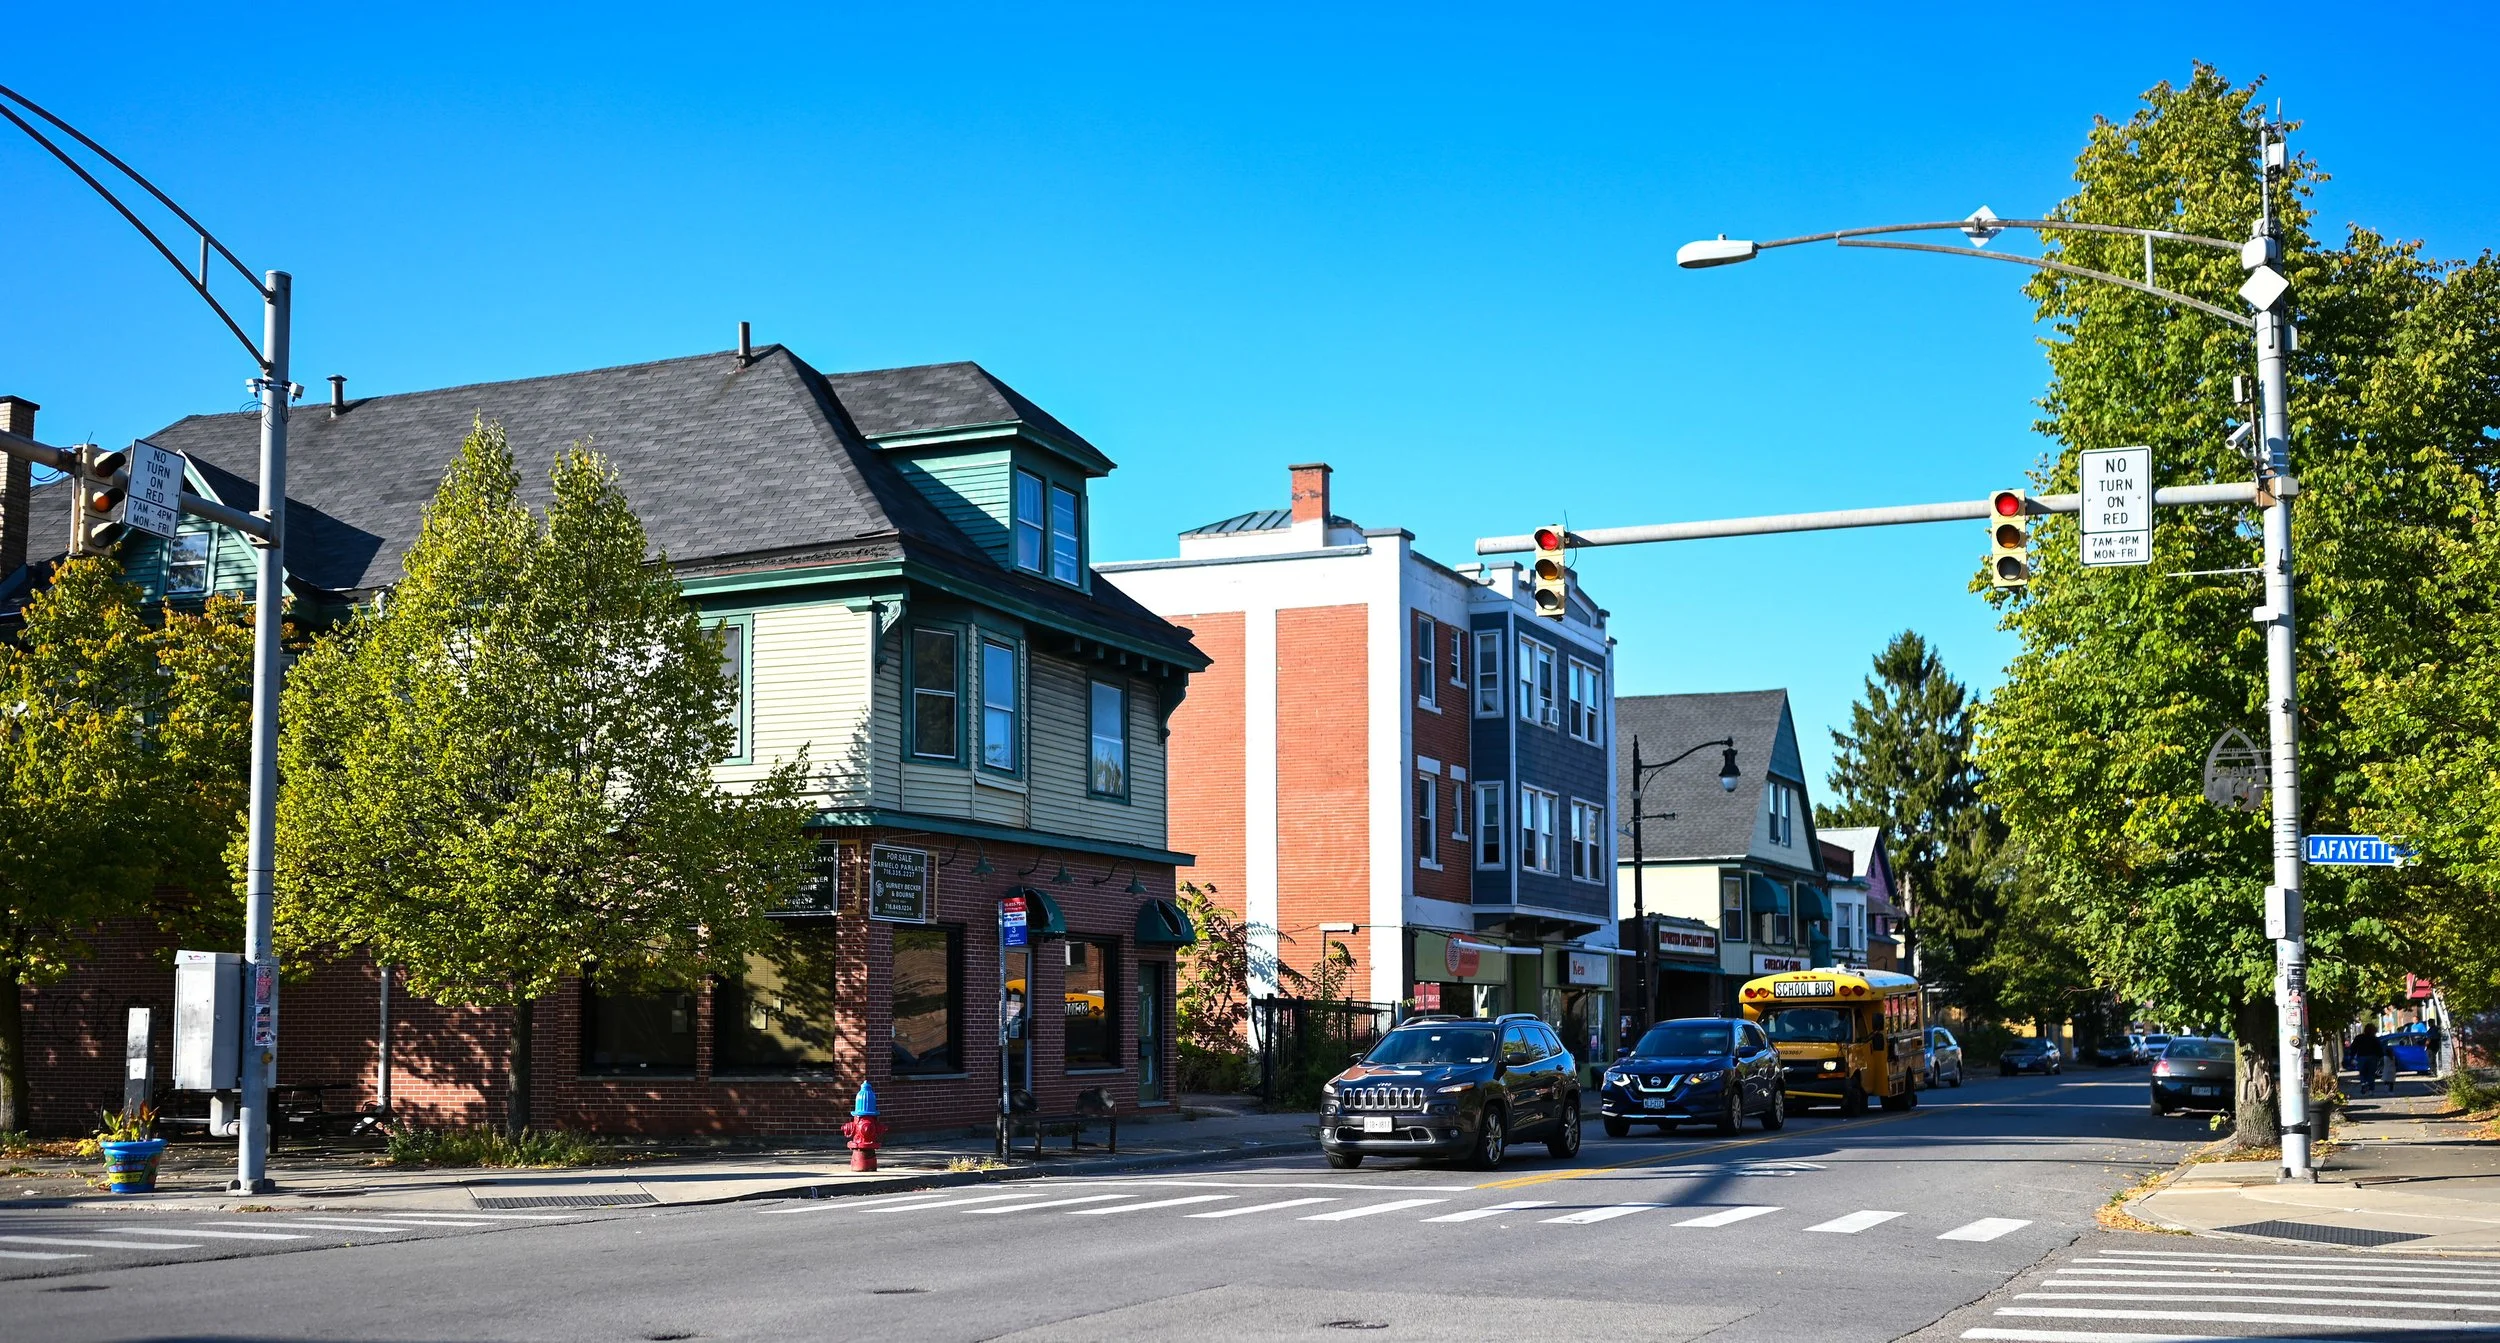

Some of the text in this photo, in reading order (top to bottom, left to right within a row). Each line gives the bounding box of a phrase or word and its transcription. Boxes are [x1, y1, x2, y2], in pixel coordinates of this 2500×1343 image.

[153, 450, 167, 464] NO
[146, 460, 171, 479] TURN
[2106, 458, 2126, 474] NO
[150, 476, 164, 490] ON
[2099, 478, 2133, 492] TURN
[145, 488, 164, 504] RED
[2107, 496, 2125, 508] ON
[133, 501, 149, 514] 7AM
[156, 509, 172, 522] 4PM
[2103, 512, 2129, 525] RED
[132, 514, 149, 528] MON
[157, 522, 170, 534] FRI
[2309, 840, 2397, 860] LAFAYETTE
[886, 852, 912, 863] FOR SALE
[873, 861, 925, 873] CARMELO PARLATO
[885, 881, 922, 892] GURNEY BECKER
[895, 891, 915, 899] BOURNE
[1011, 926, 1017, 934] 3
[1776, 982, 1833, 996] SCHOOL BUS
